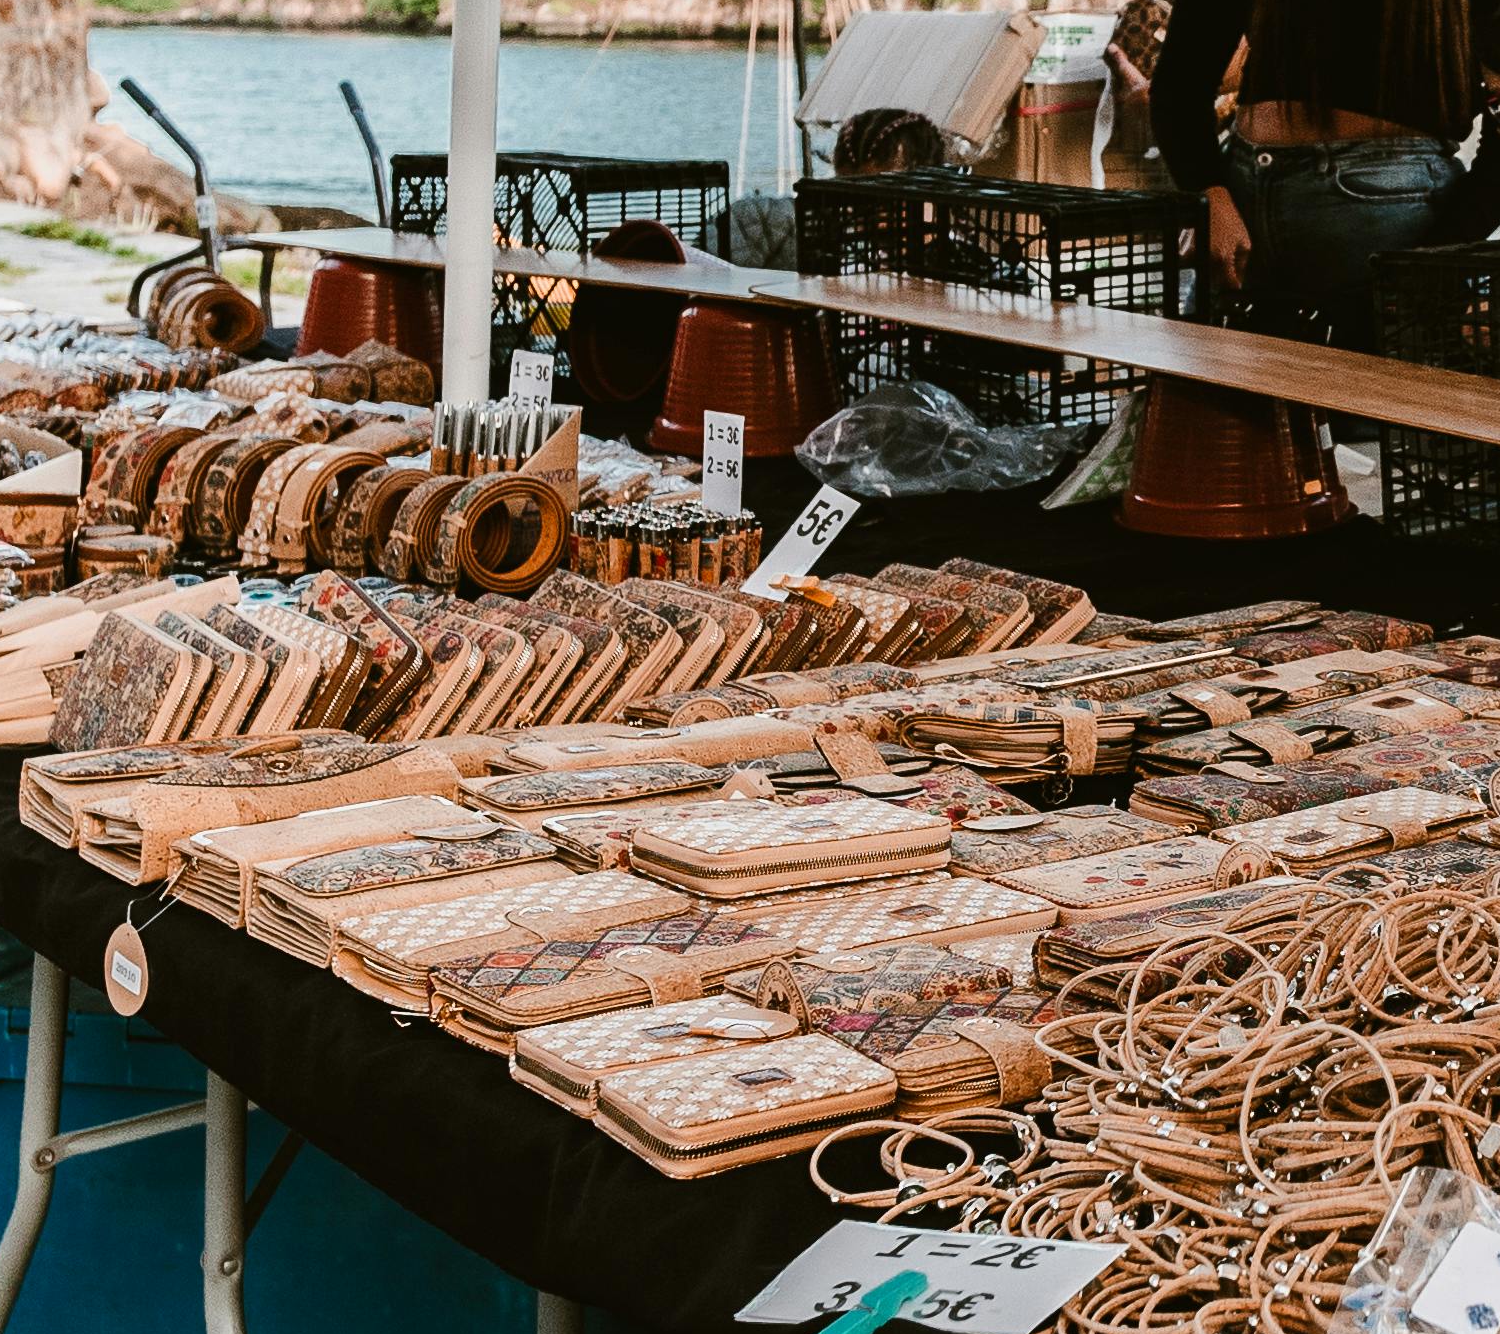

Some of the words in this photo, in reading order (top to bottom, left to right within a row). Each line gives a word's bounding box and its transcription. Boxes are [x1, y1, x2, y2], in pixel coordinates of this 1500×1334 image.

[708, 423, 714, 441] 1
[726, 426, 739, 445] 3€
[707, 456, 714, 474] 2
[726, 459, 739, 479] 5€
[796, 499, 844, 546] 5€
[874, 1233, 922, 1258] 1
[927, 1241, 972, 1259] =
[970, 1241, 1057, 1271] 2€
[813, 1281, 862, 1313] 3
[912, 1288, 996, 1323] 5€
